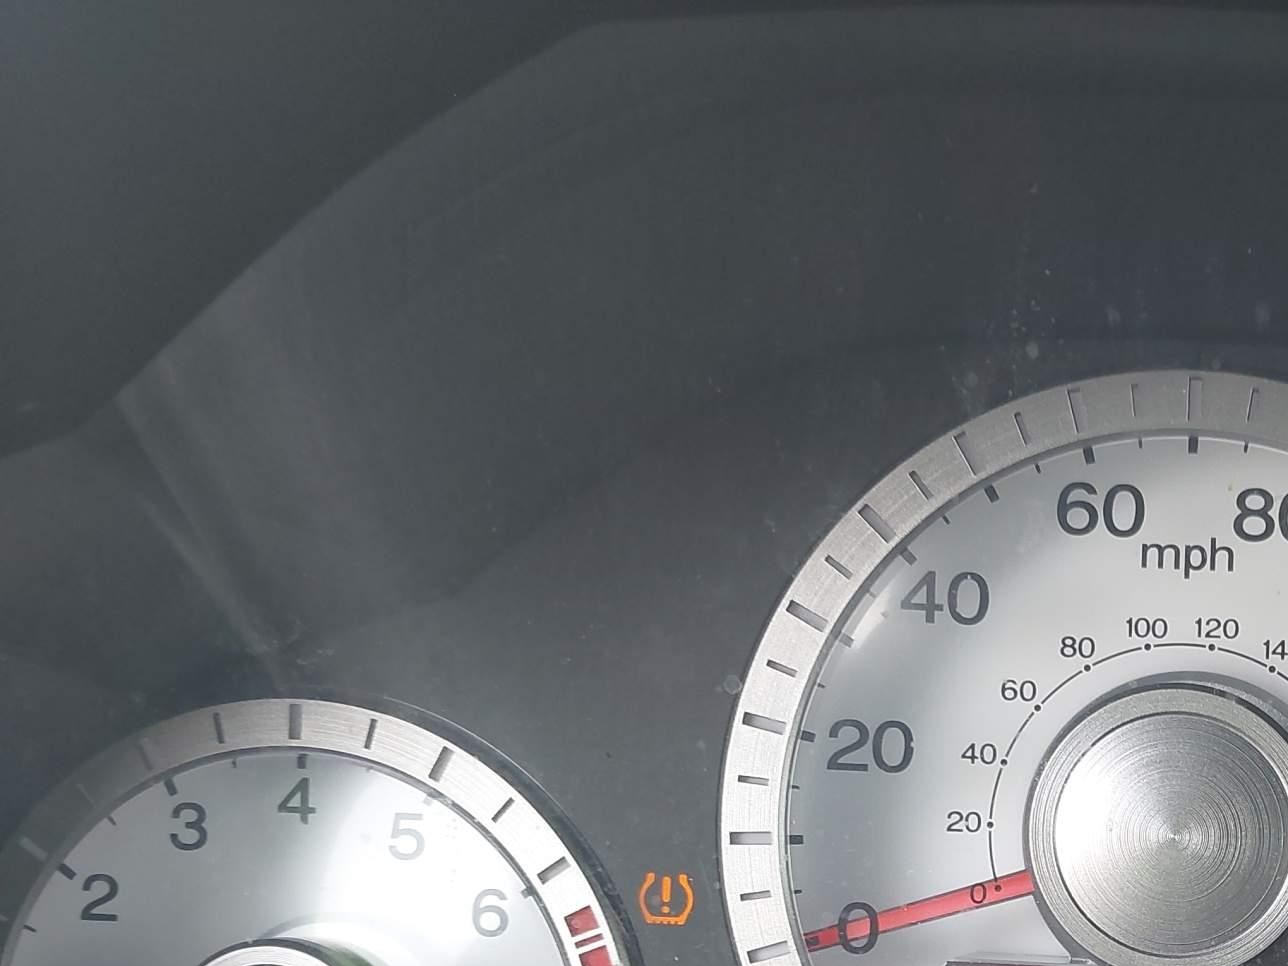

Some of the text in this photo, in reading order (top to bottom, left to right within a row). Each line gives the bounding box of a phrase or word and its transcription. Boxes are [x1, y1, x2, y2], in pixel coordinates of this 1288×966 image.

[1057, 482, 1145, 537] 60
[1141, 538, 1235, 579] mph
[901, 571, 989, 625] 40
[1060, 637, 1096, 658] 80
[1126, 618, 1168, 639] 100
[1195, 619, 1239, 640] 120
[1000, 681, 1037, 701] 60
[827, 720, 914, 773] 20
[961, 743, 997, 765] 40
[278, 777, 316, 824] 4
[946, 812, 982, 833] 20
[170, 802, 208, 851] 3
[388, 812, 425, 860] 5
[81, 873, 119, 922] 2
[472, 889, 509, 937] 6
[970, 883, 987, 904] 0
[838, 902, 879, 954] 0
